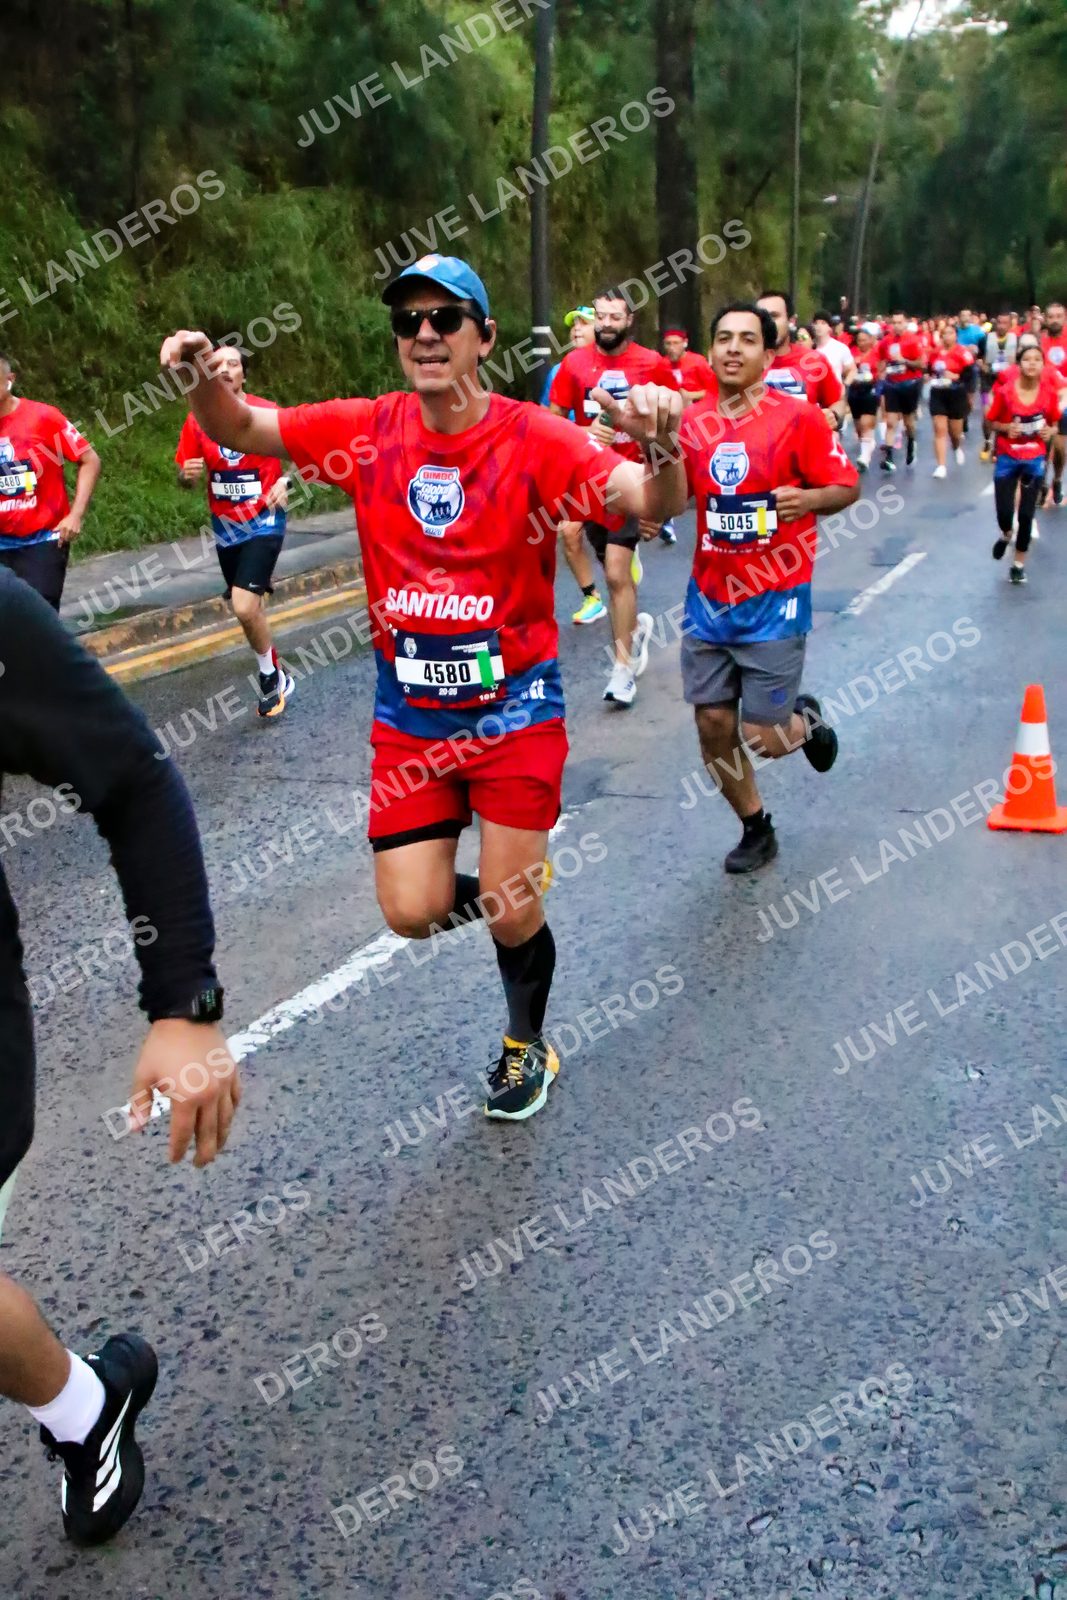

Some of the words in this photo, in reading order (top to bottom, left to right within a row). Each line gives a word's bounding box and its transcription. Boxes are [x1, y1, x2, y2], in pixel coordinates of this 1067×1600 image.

[422, 471, 454, 480] BIMBO
[224, 484, 246, 494] 5066
[720, 514, 753, 530] 5045
[385, 587, 494, 621] SANTIAGO
[424, 662, 471, 684] 4580
